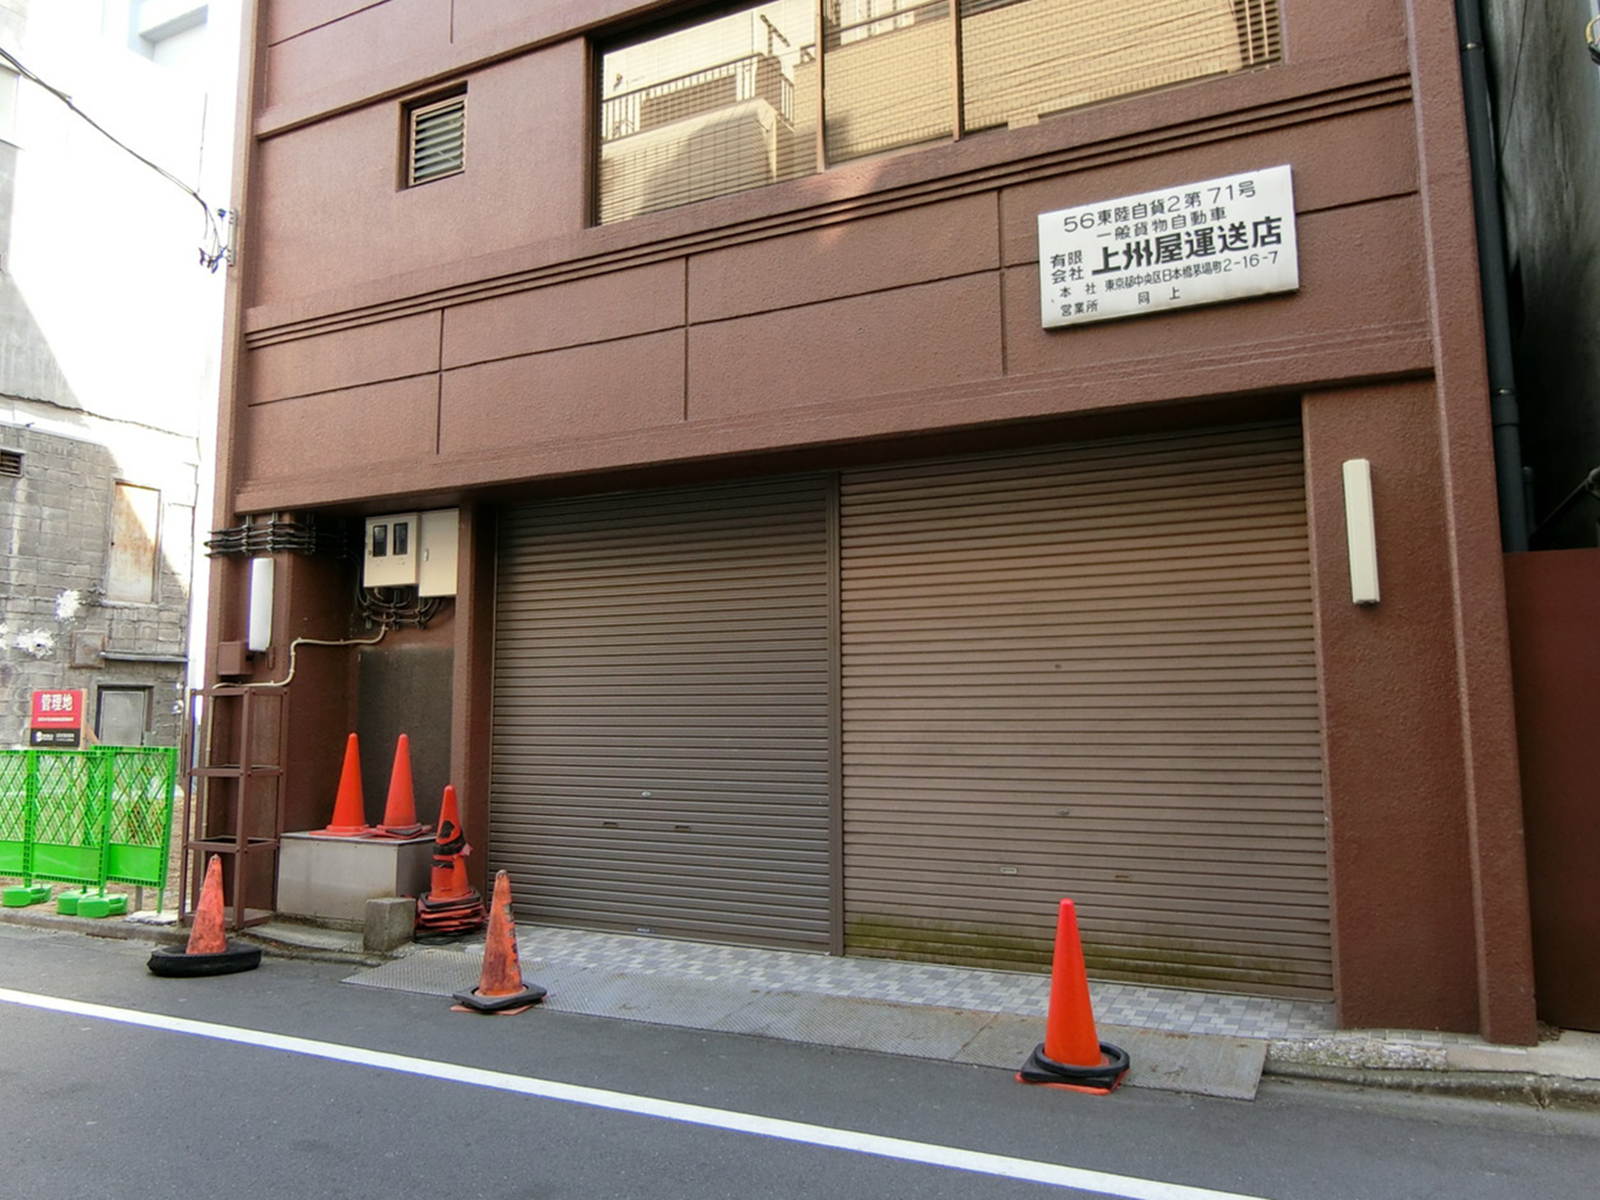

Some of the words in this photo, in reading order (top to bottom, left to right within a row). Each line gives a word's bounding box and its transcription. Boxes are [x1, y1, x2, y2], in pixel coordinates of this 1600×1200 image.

[1097, 206, 1227, 241] 一般貨物自動車
[1092, 216, 1283, 276] 上州屋運送店
[1050, 249, 1083, 269] 有限
[1051, 265, 1084, 285] 会社
[1060, 299, 1098, 317] 営業所
[41, 693, 74, 711] 管理地
